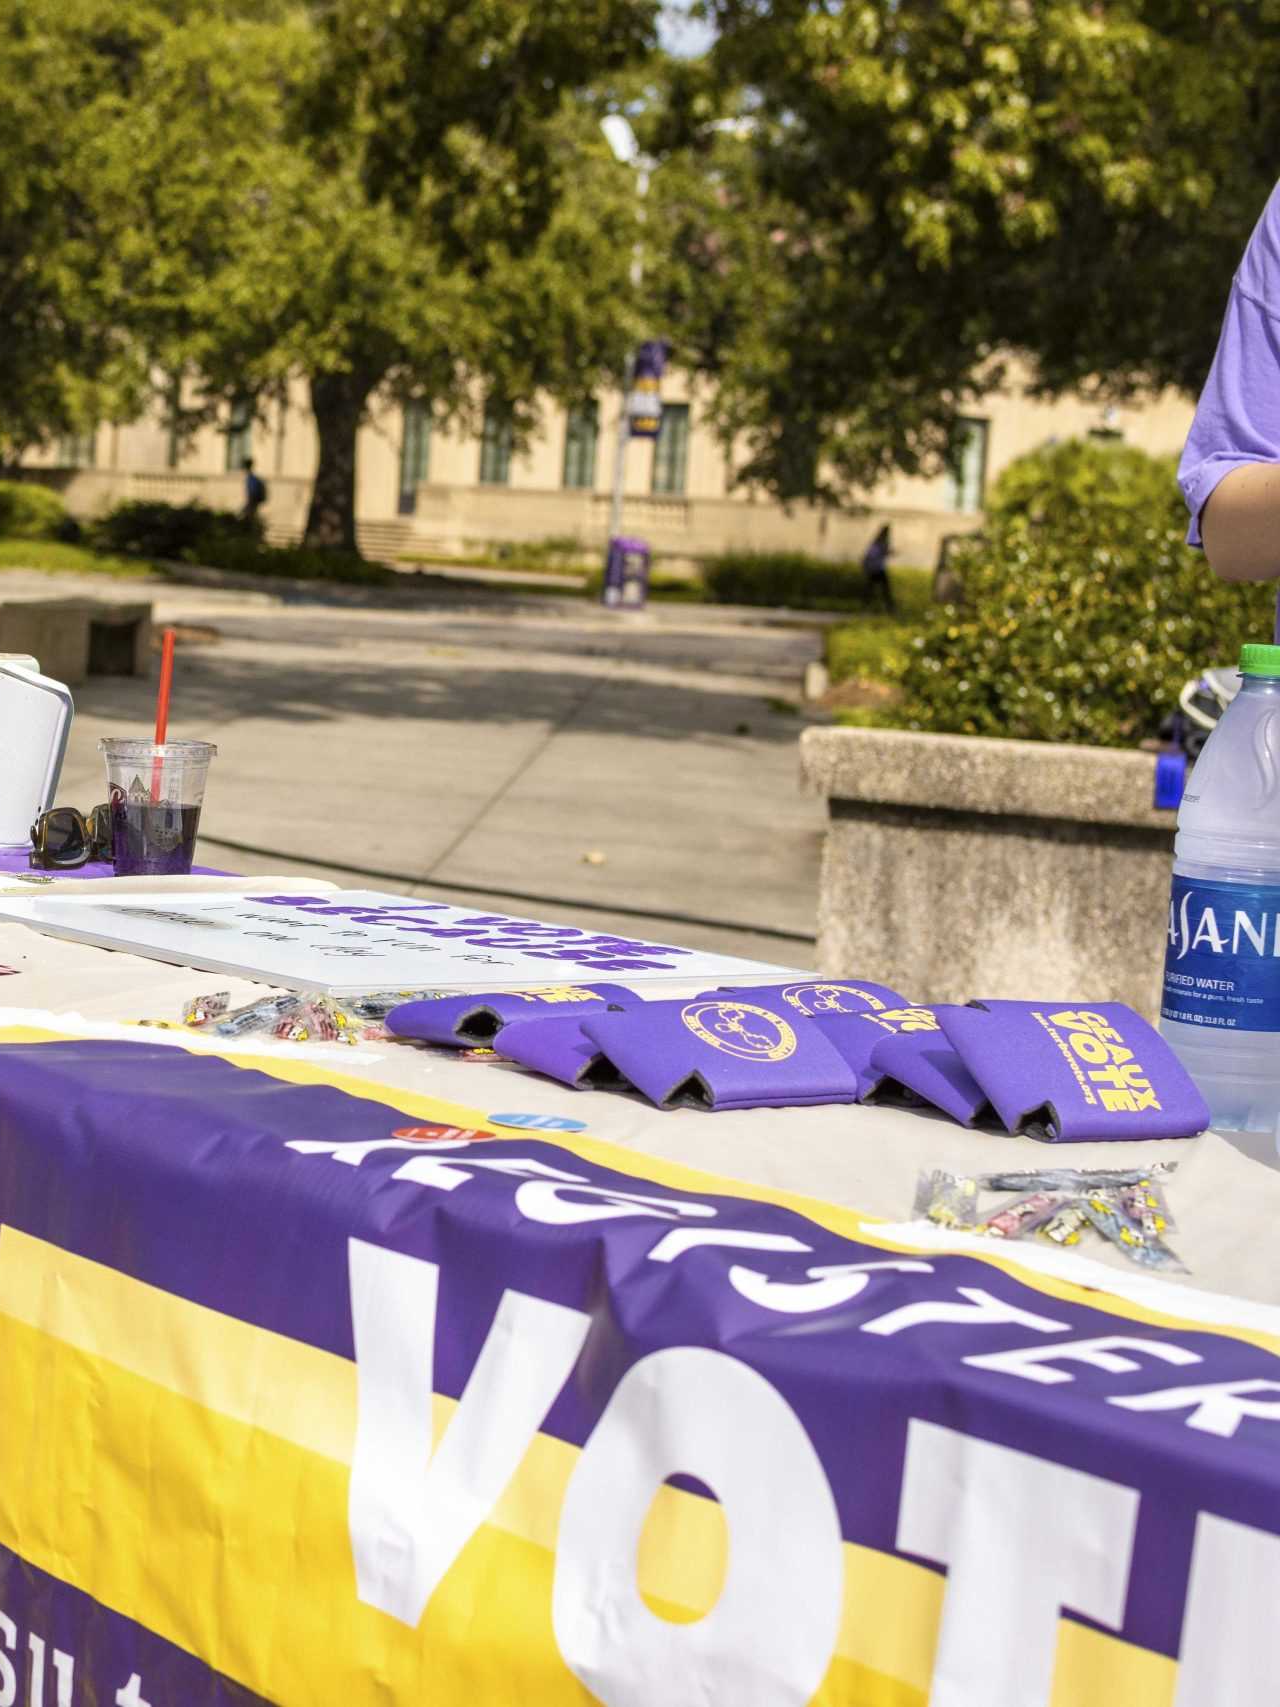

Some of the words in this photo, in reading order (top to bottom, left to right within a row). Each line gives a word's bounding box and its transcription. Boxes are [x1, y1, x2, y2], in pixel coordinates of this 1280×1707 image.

[243, 895, 677, 971] BECAUSE
[452, 916, 694, 956] VOTE
[1196, 977, 1234, 992] WATER
[1047, 1010, 1140, 1112] VOTE
[1077, 1010, 1162, 1111] GEAUX
[284, 1137, 1280, 1438] REGISTER
